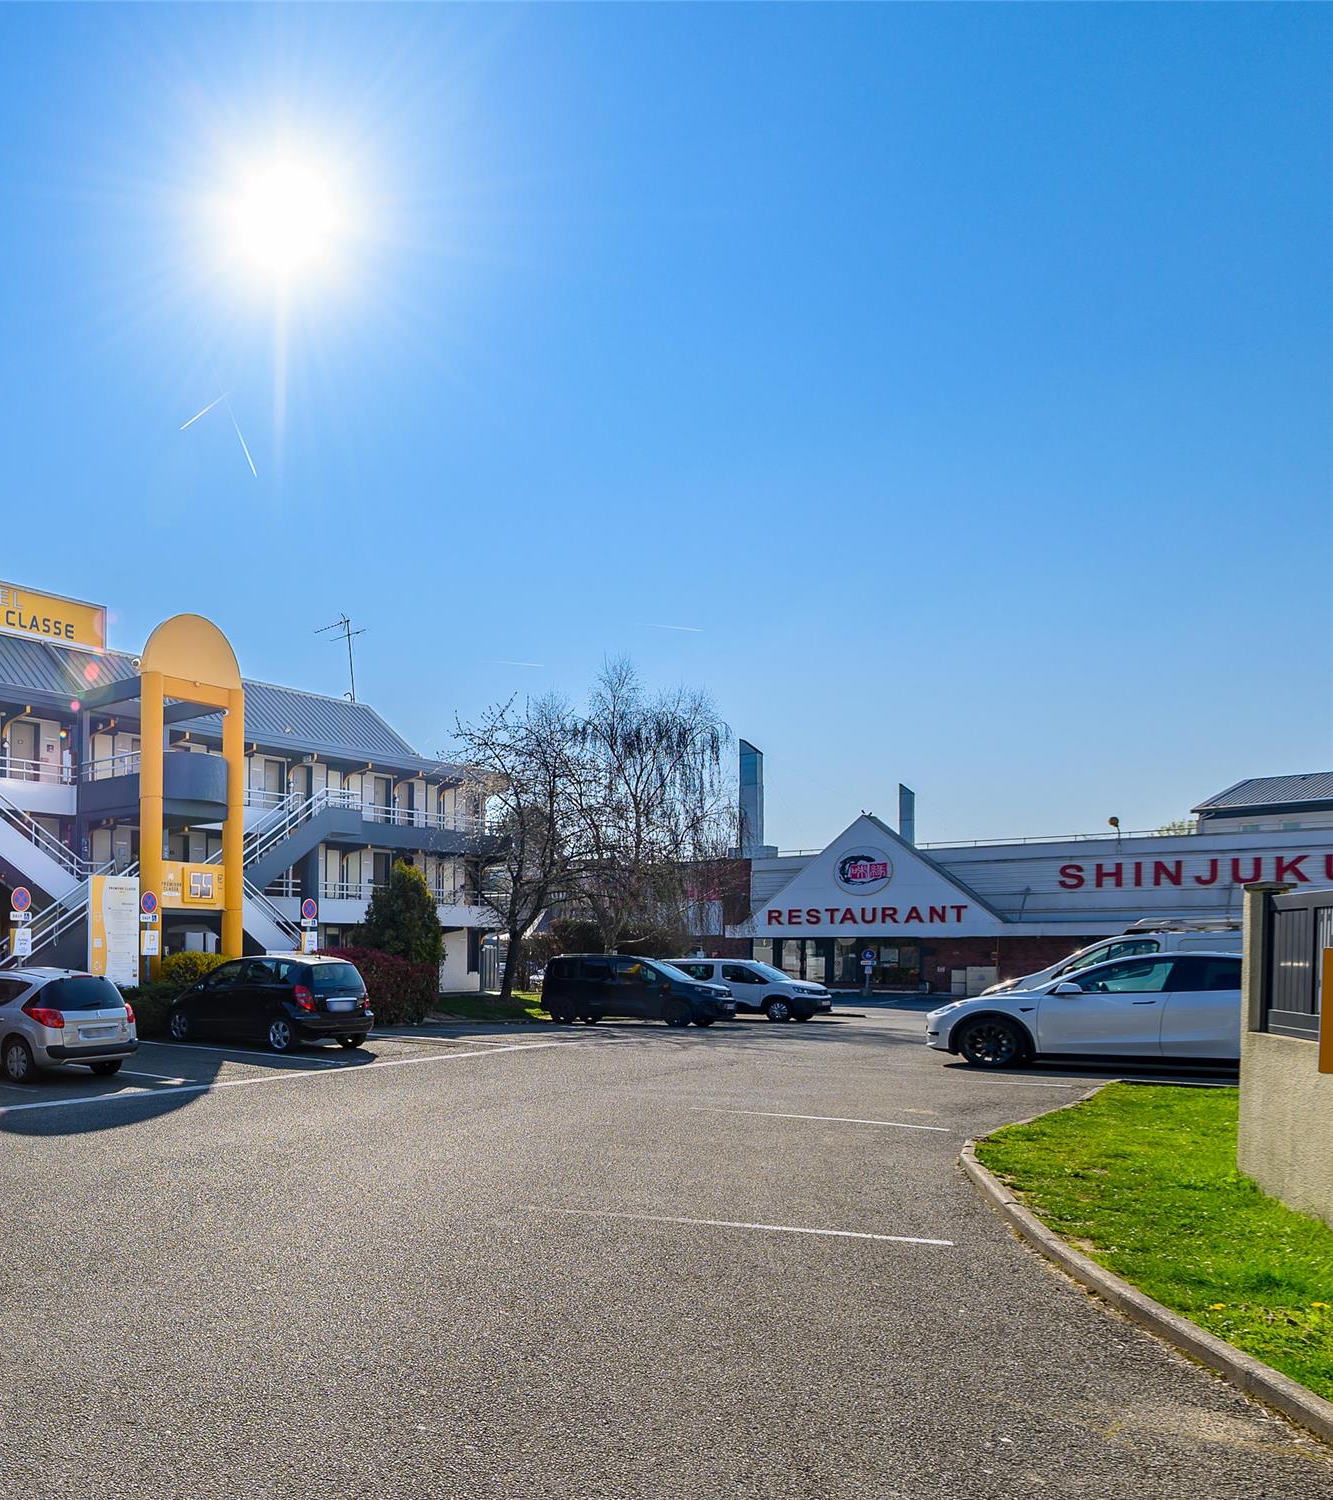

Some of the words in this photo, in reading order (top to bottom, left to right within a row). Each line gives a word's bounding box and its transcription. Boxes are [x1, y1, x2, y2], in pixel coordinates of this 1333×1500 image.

[5, 610, 75, 639] CLASSE
[189, 872, 213, 899] 55
[768, 905, 968, 926] RESTAURANT
